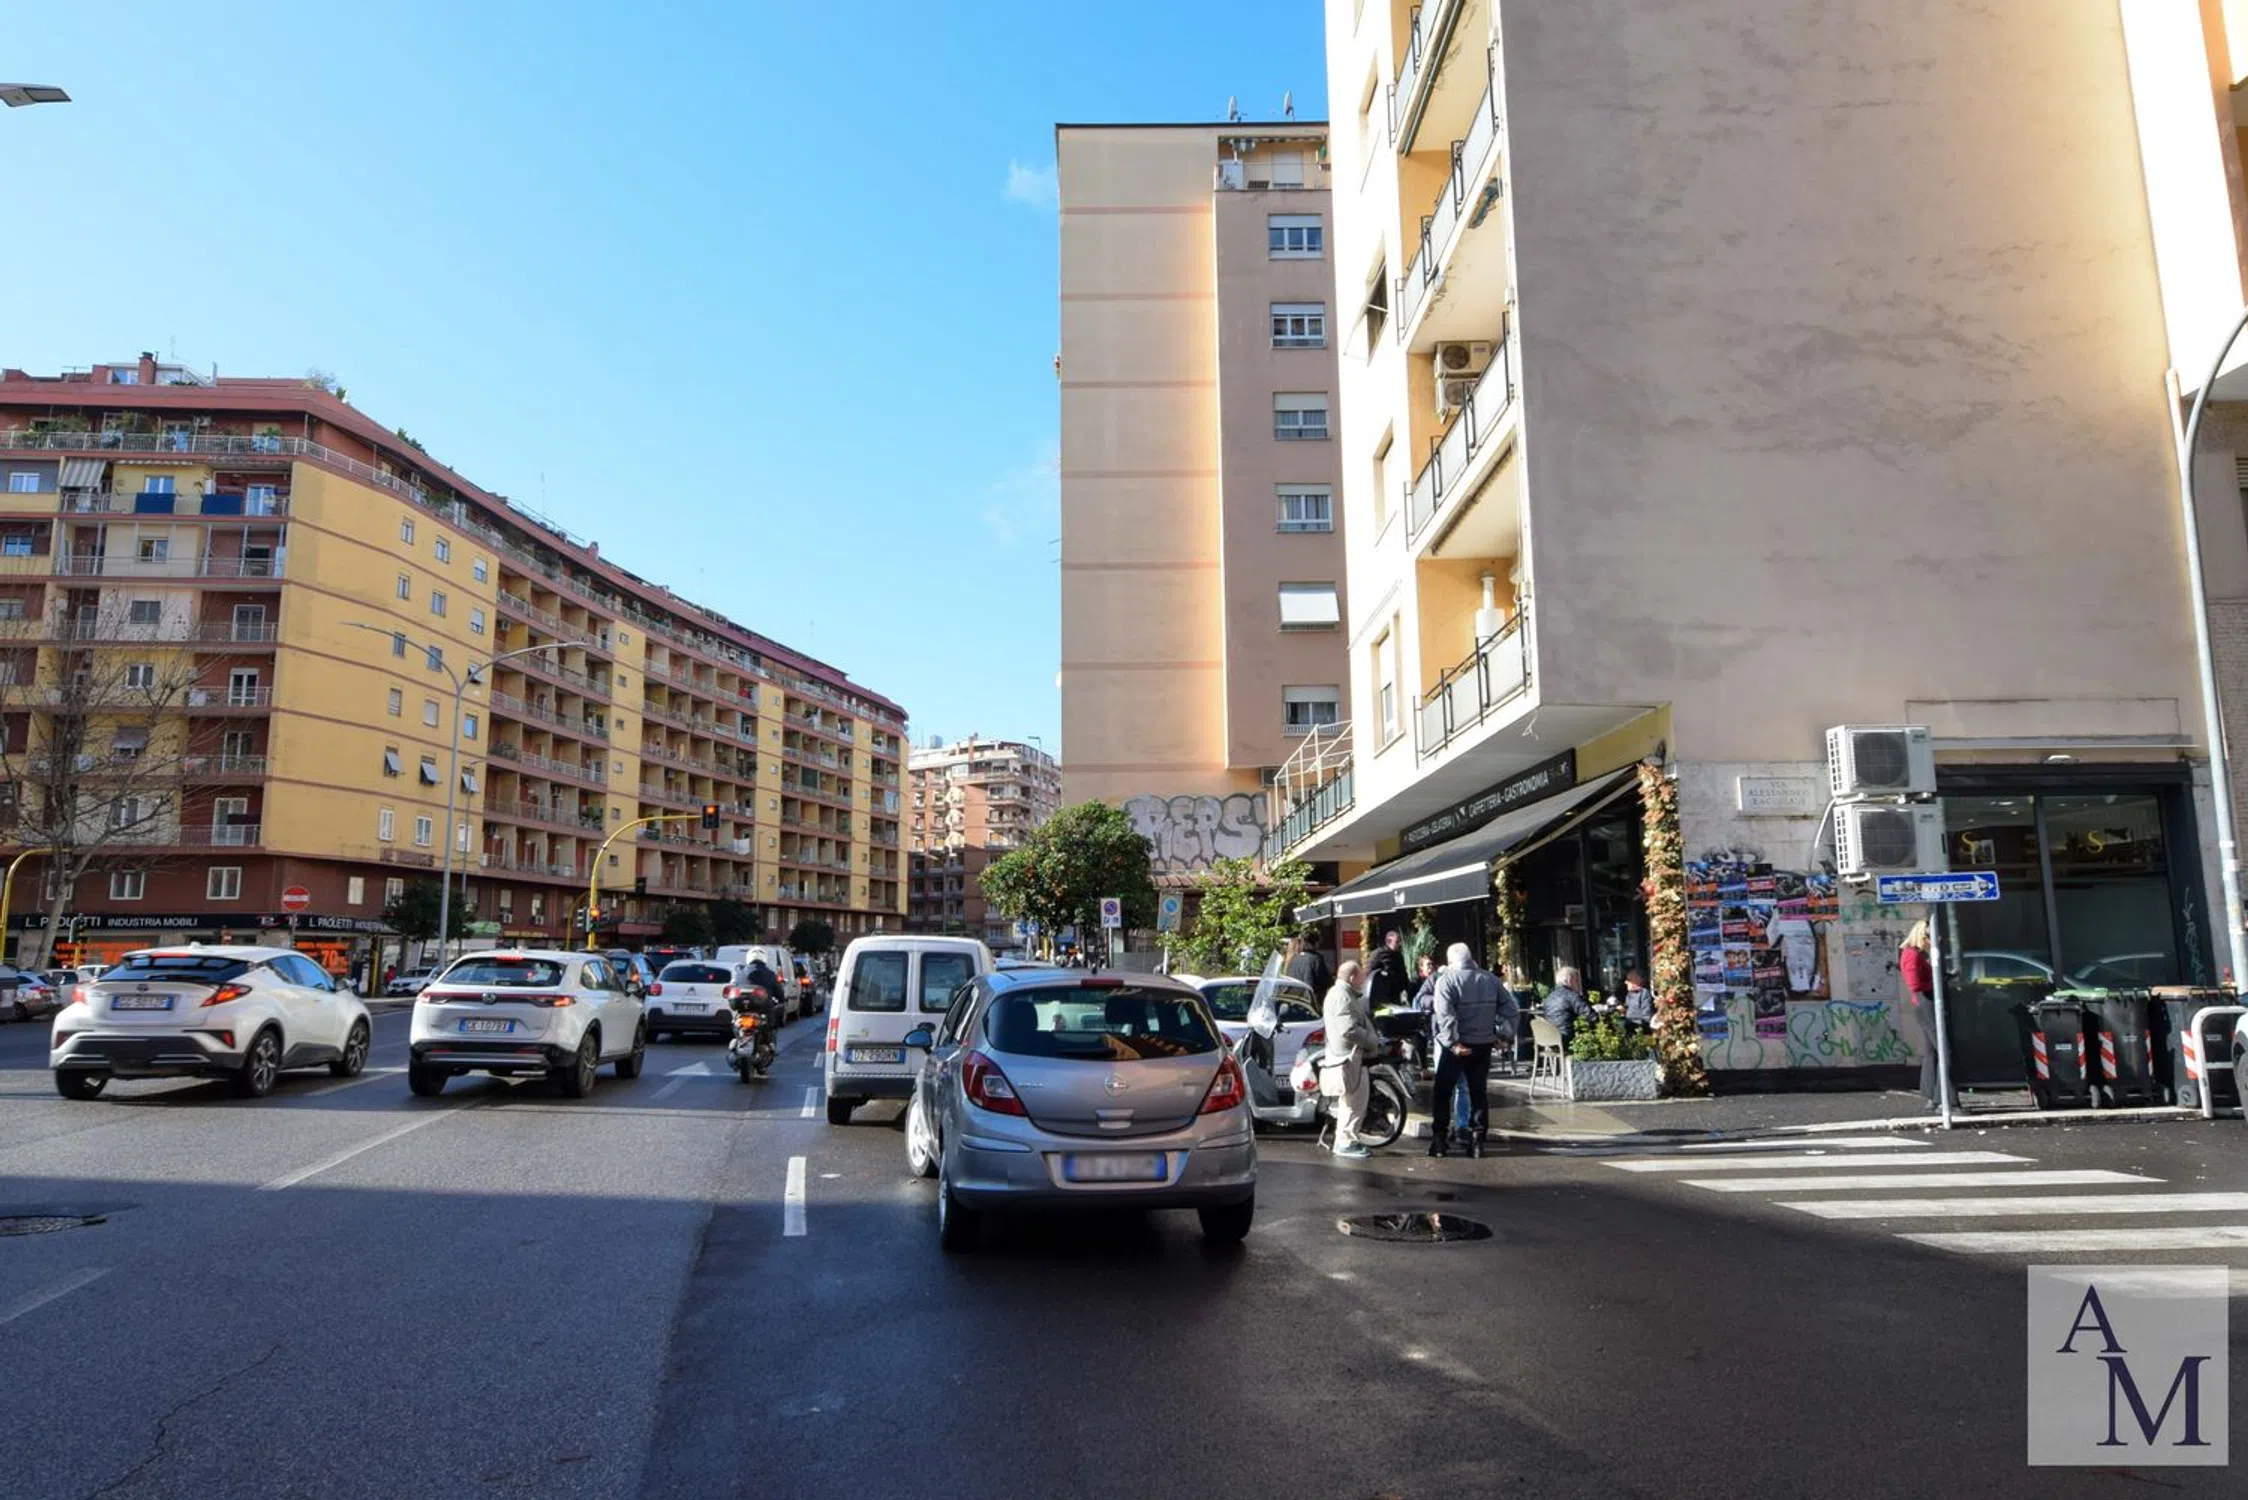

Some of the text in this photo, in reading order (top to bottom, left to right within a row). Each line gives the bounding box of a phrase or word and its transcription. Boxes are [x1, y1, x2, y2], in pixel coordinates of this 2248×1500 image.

[1504, 770, 1549, 803] GASTRONOMIA
[40, 917, 101, 927] POLTTI
[107, 917, 162, 927] INDUSTRIA
[163, 917, 198, 927] MOBILI
[317, 917, 353, 930] PAOLETTI
